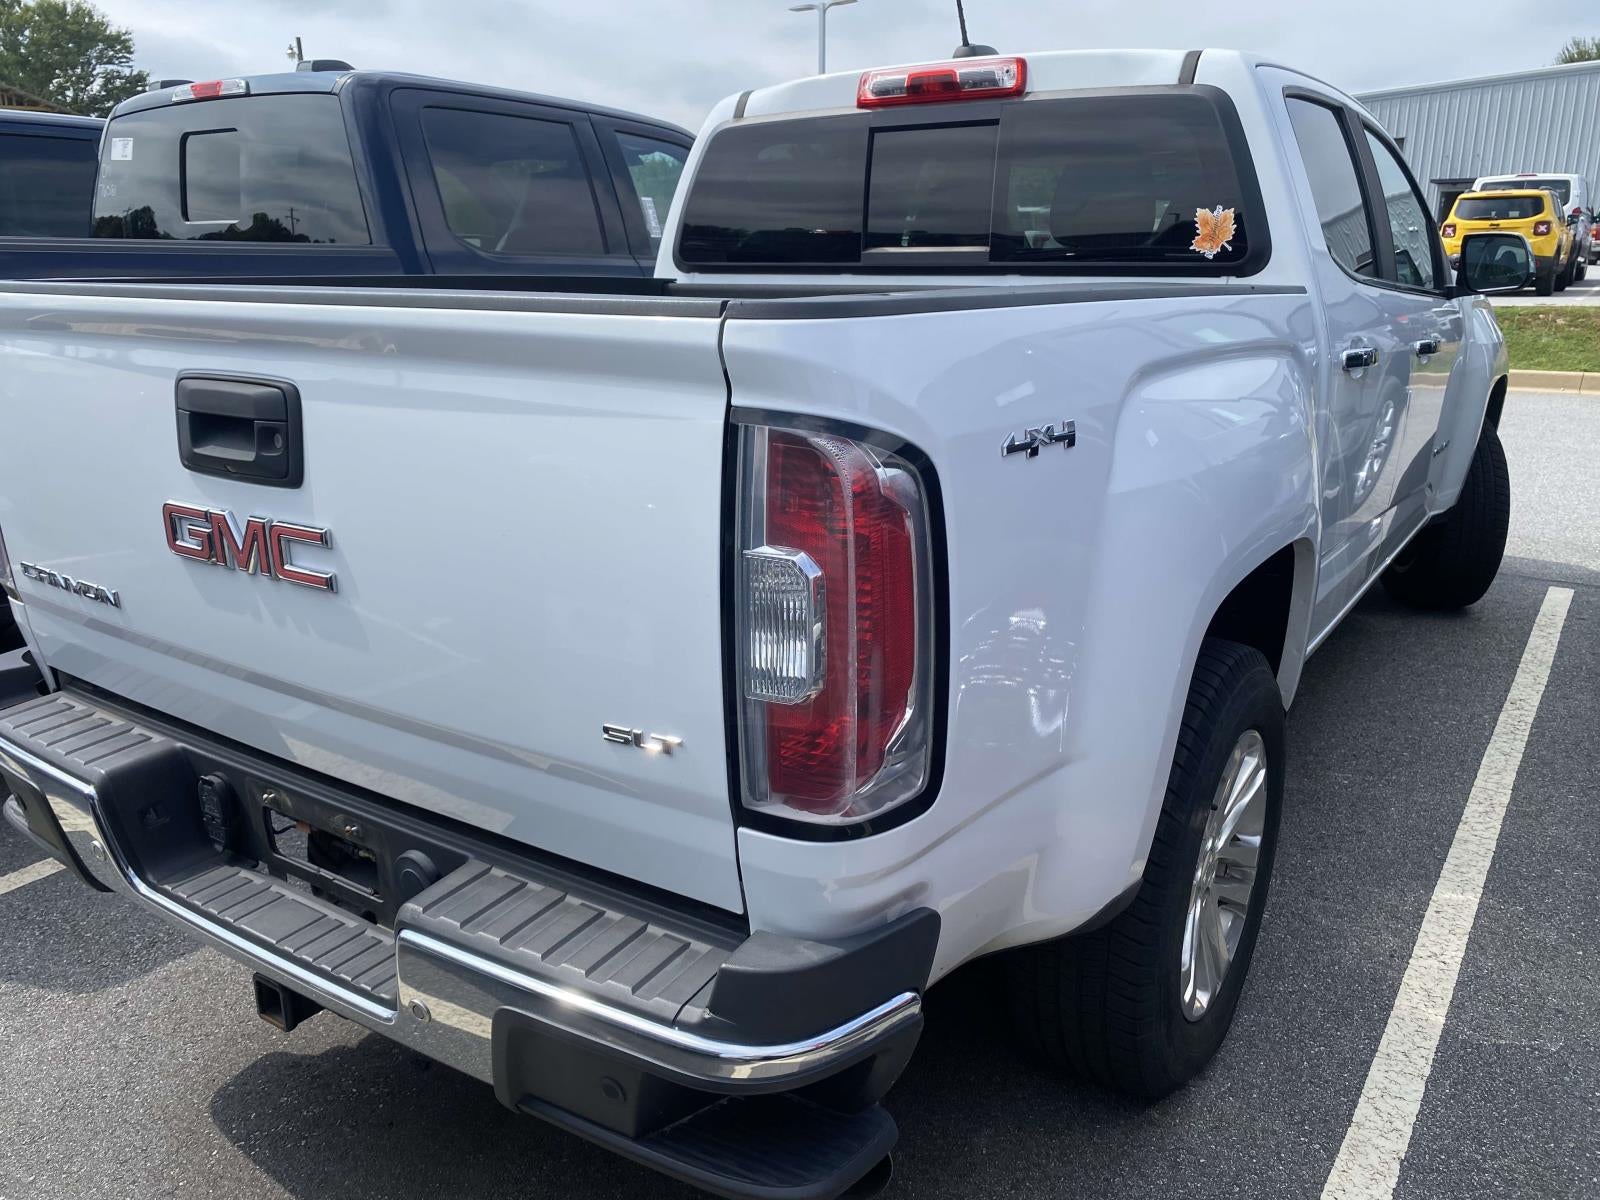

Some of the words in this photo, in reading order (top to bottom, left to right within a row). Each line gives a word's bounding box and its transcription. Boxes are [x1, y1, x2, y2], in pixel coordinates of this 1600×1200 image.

[162, 500, 338, 593] GMC
[20, 560, 122, 609] CANYON
[602, 723, 684, 755] SLT
